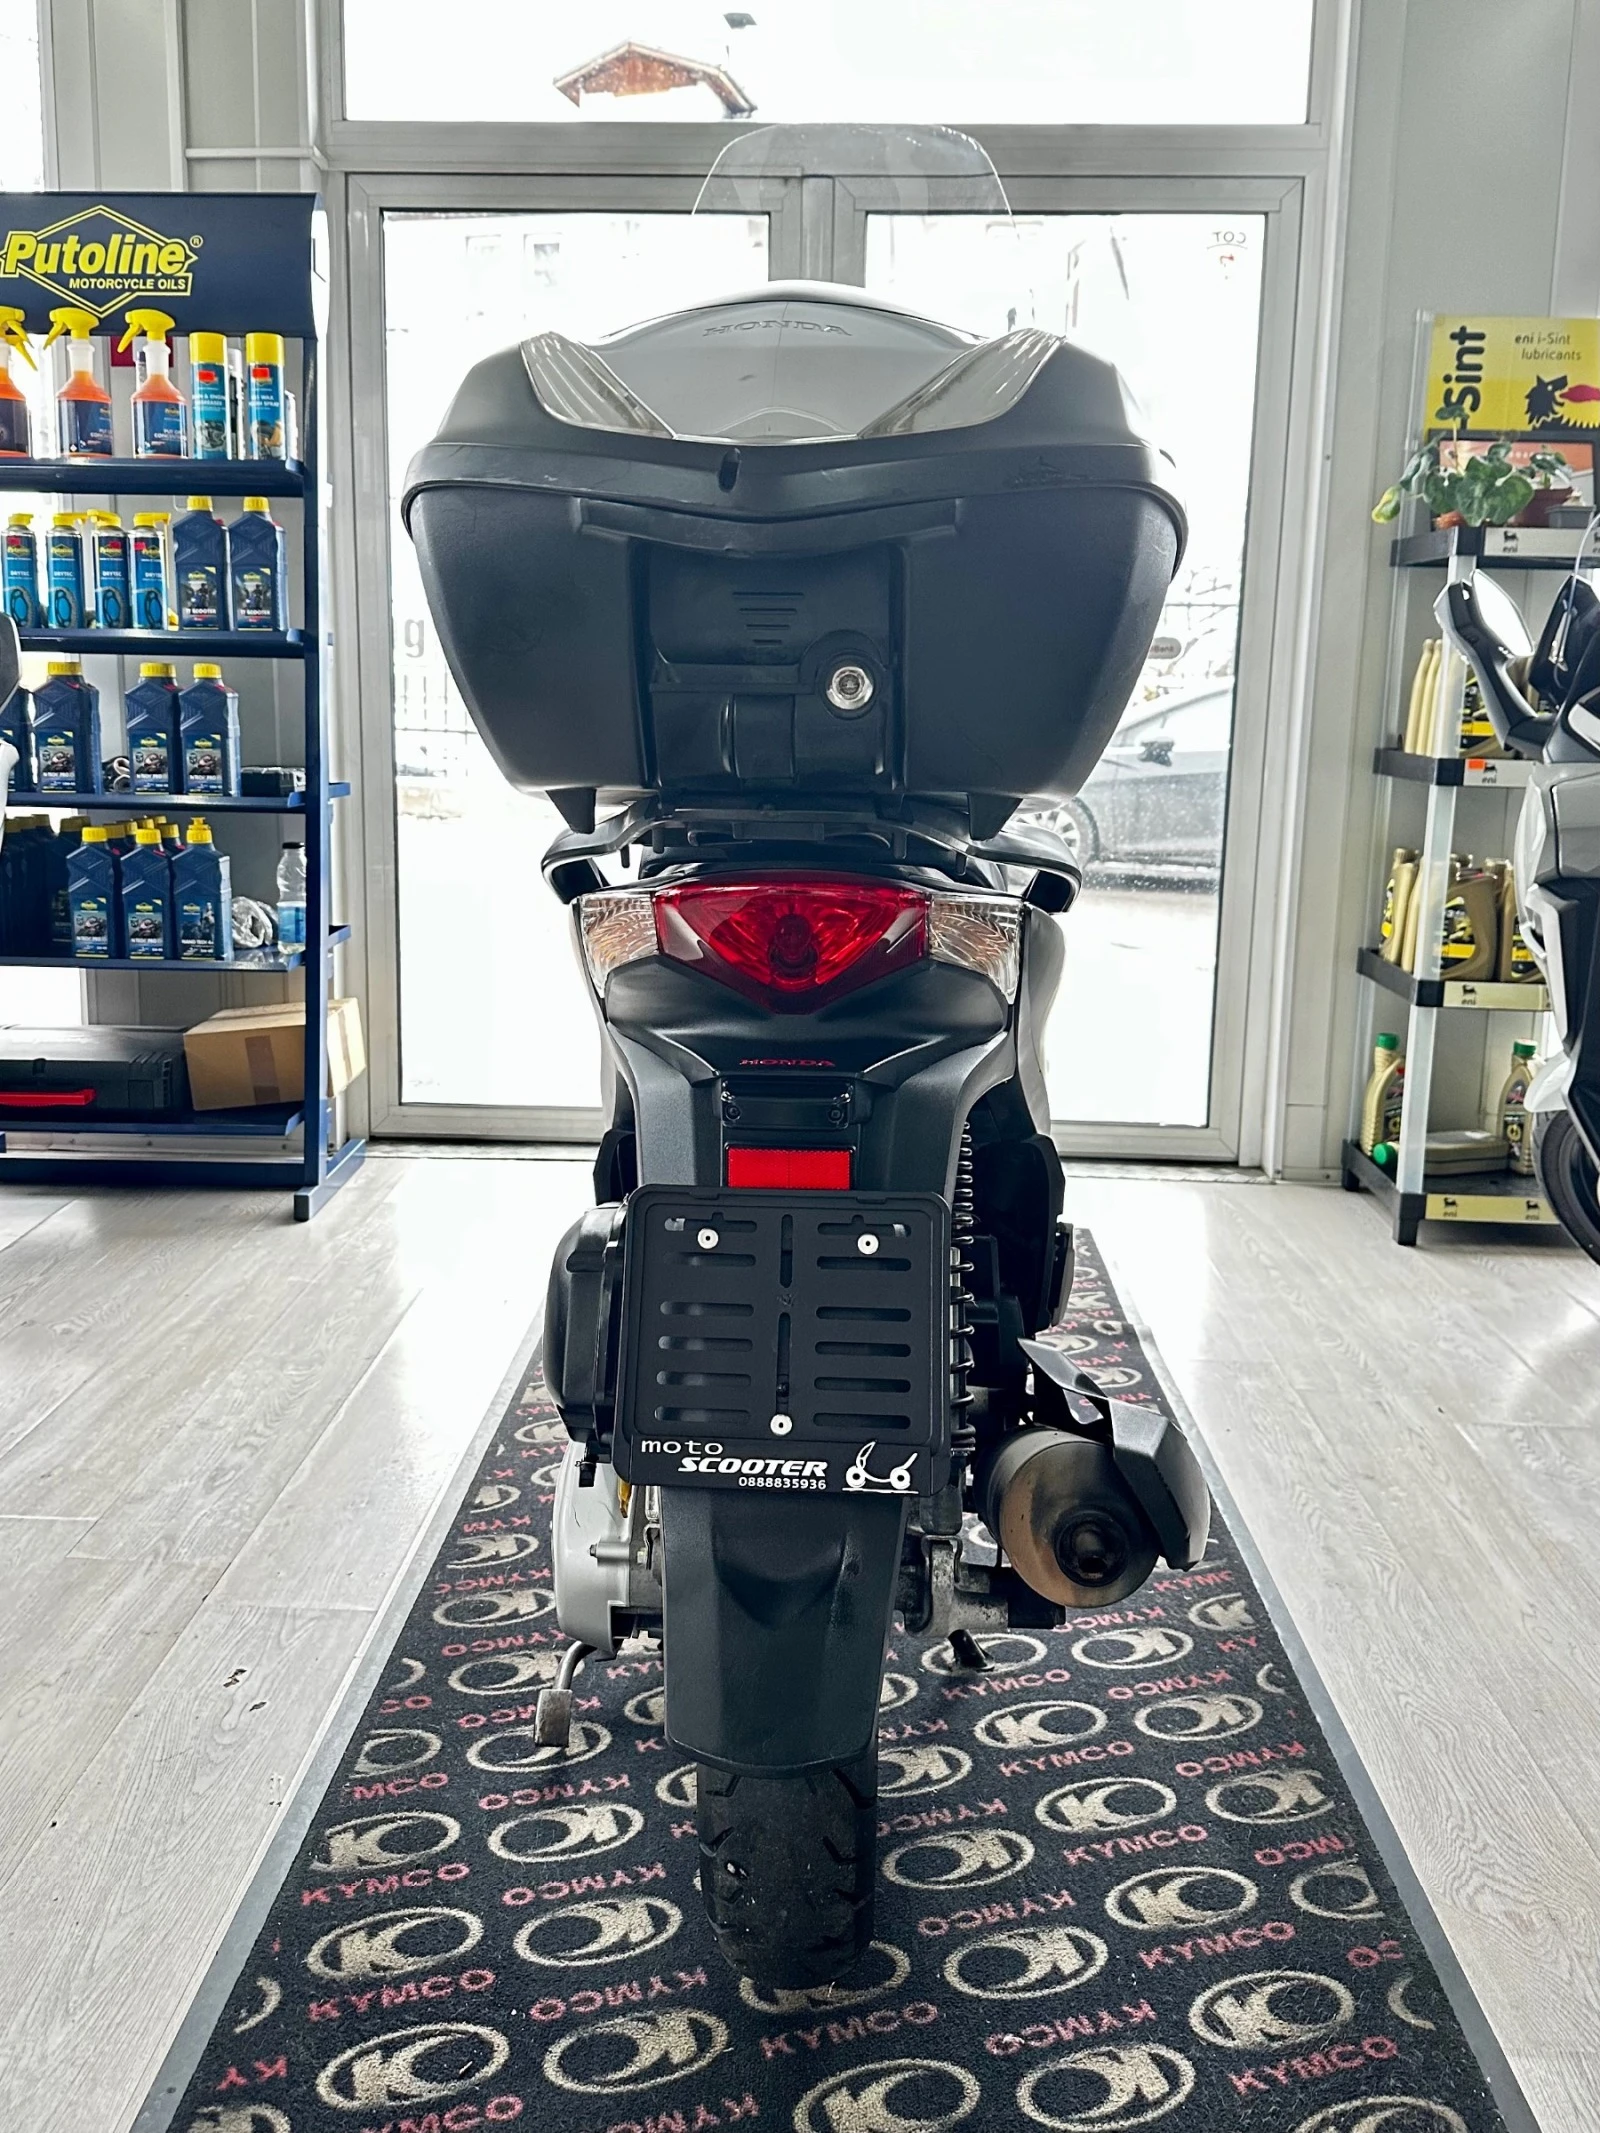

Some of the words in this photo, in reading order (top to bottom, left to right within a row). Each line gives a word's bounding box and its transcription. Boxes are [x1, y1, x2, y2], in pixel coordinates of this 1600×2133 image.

[4, 232, 187, 276] Putoline
[69, 278, 154, 290] MOTORCYCLE
[157, 278, 187, 290] OILS
[702, 319, 853, 337] HONDA
[1514, 332, 1535, 344] eni
[1521, 349, 1582, 361] lubricants
[739, 1058, 836, 1068] HONDA
[641, 1440, 723, 1455] moto
[678, 1457, 828, 1477] SCOOTER
[738, 1476, 827, 1490] 0888835936
[943, 1668, 1071, 1701] KYMCO
[1108, 1669, 1233, 1700] KYMCO
[998, 1740, 1135, 1778] KYMCO
[1175, 1740, 1308, 1778] KYMCO
[478, 1773, 631, 1811] KYMCO
[1063, 1824, 1208, 1866] KYMCO
[301, 1862, 471, 1906] KYMCO
[501, 1861, 667, 1907] KYMCO
[917, 1889, 1077, 1937] KYMCO
[1138, 1921, 1296, 1969] KYMCO
[307, 1968, 497, 2023] KYMCO
[529, 1967, 708, 2022] KYMCO
[759, 2001, 938, 2060] KYMCO
[985, 1998, 1157, 2055] KYMCO
[1228, 2035, 1399, 2096] KYMCO
